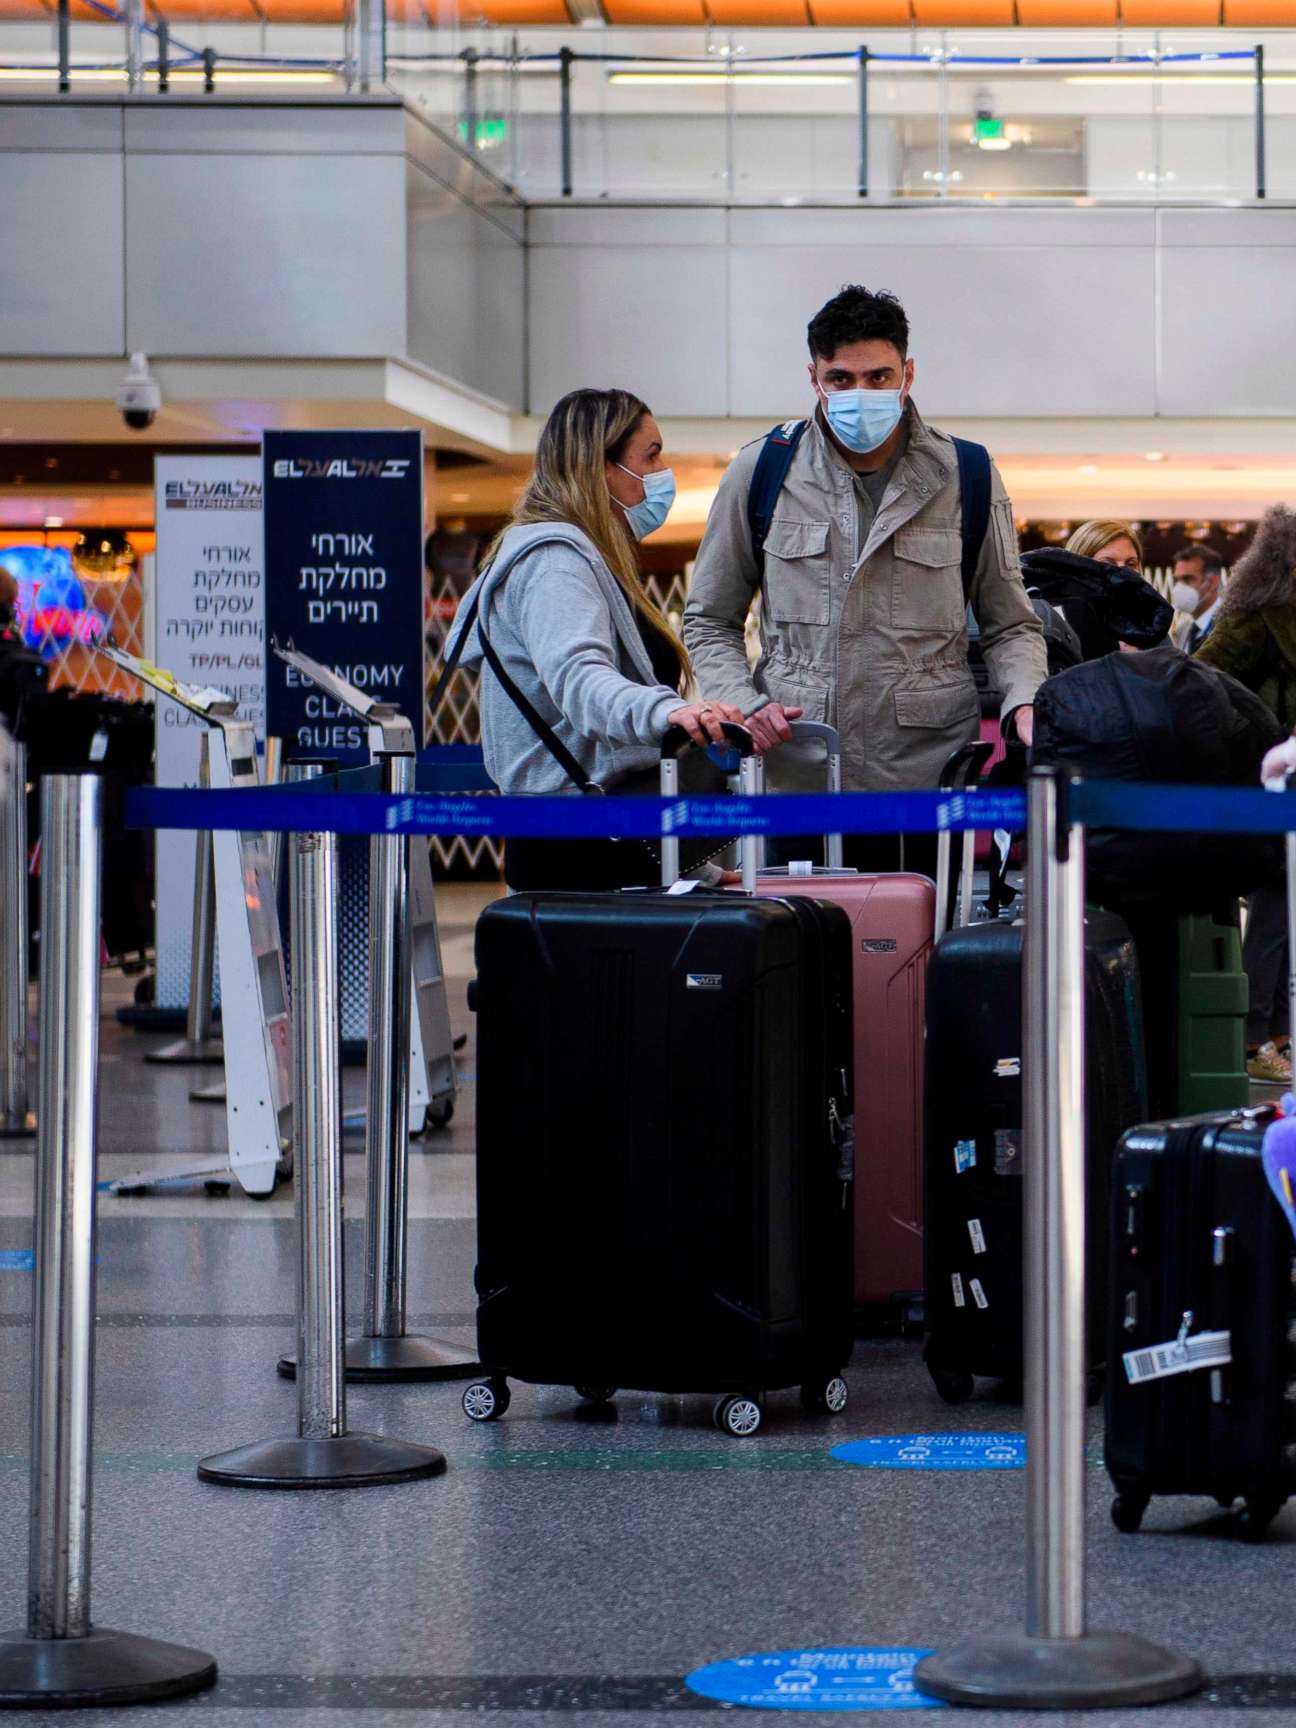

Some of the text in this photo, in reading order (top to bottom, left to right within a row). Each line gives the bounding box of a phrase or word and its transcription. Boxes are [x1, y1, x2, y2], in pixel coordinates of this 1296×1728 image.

[203, 546, 251, 562] אורחי
[311, 533, 374, 557] אורחי
[193, 568, 260, 592] מחלקת
[299, 563, 387, 597] מחלקת
[195, 595, 254, 616] עסקים
[308, 600, 378, 624] תיירים
[167, 620, 214, 642] יוקרה
